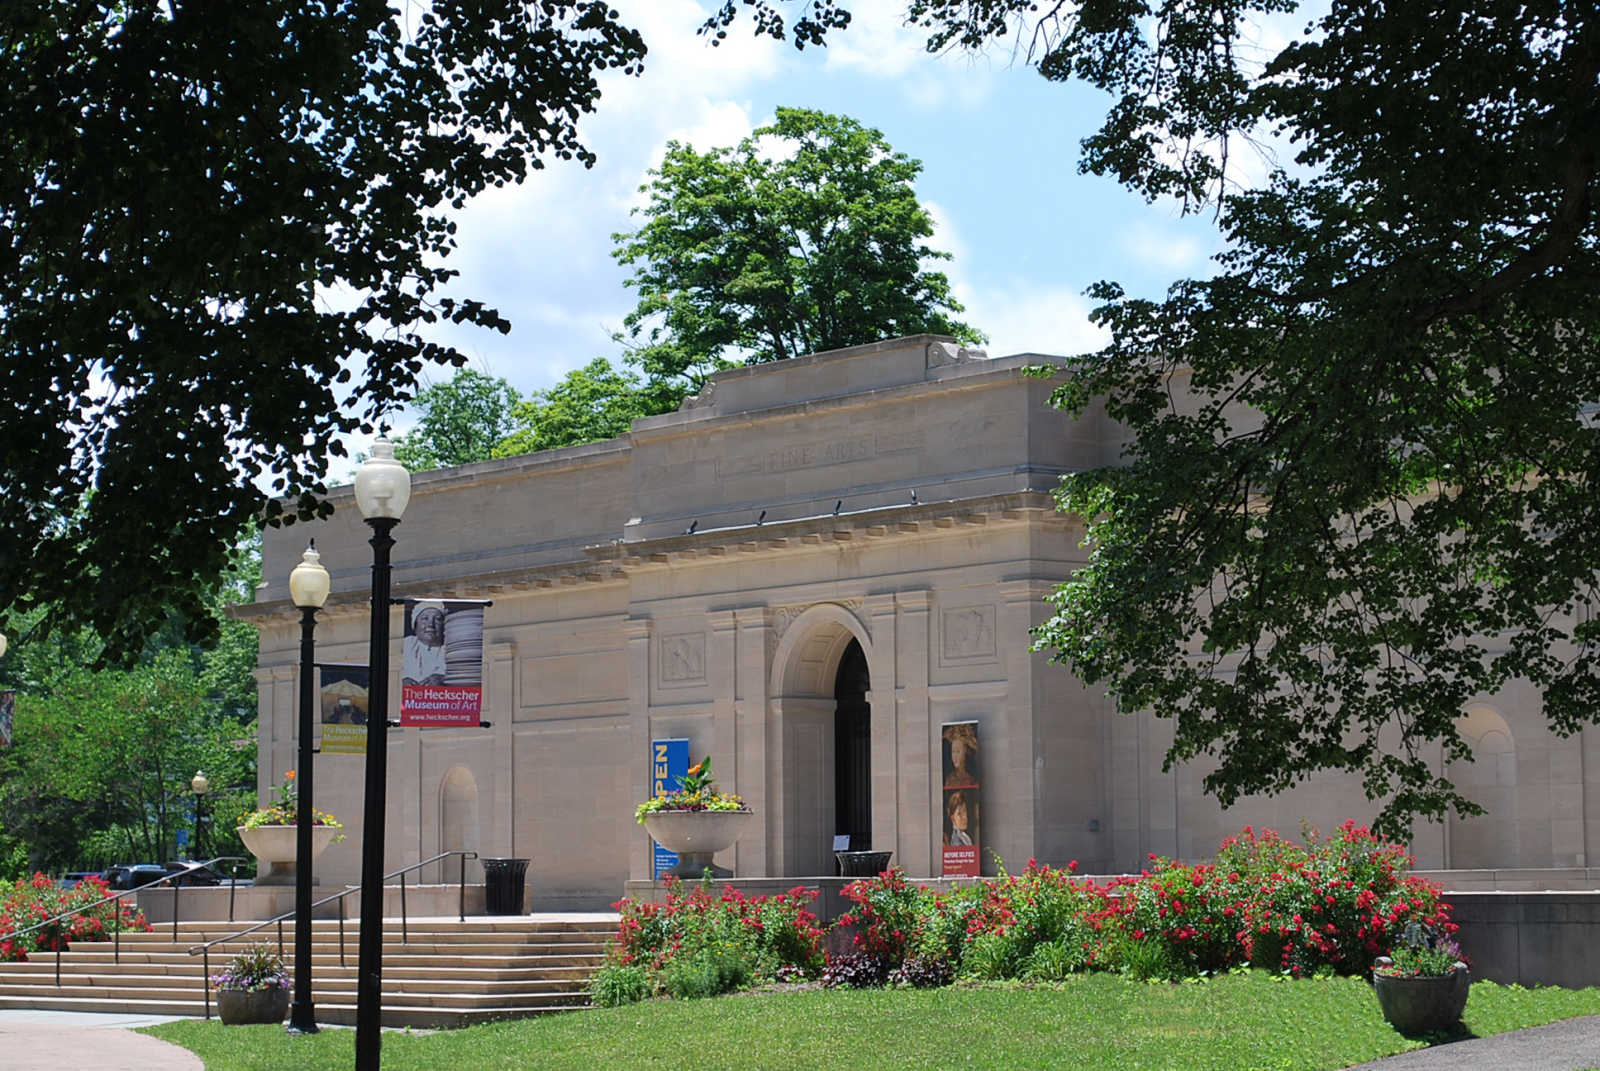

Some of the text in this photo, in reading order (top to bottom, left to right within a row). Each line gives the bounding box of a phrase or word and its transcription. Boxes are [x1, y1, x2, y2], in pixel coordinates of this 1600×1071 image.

[404, 689, 479, 701] The Heckscher
[404, 700, 477, 711] Museum of Art
[655, 744, 668, 797] PEN
